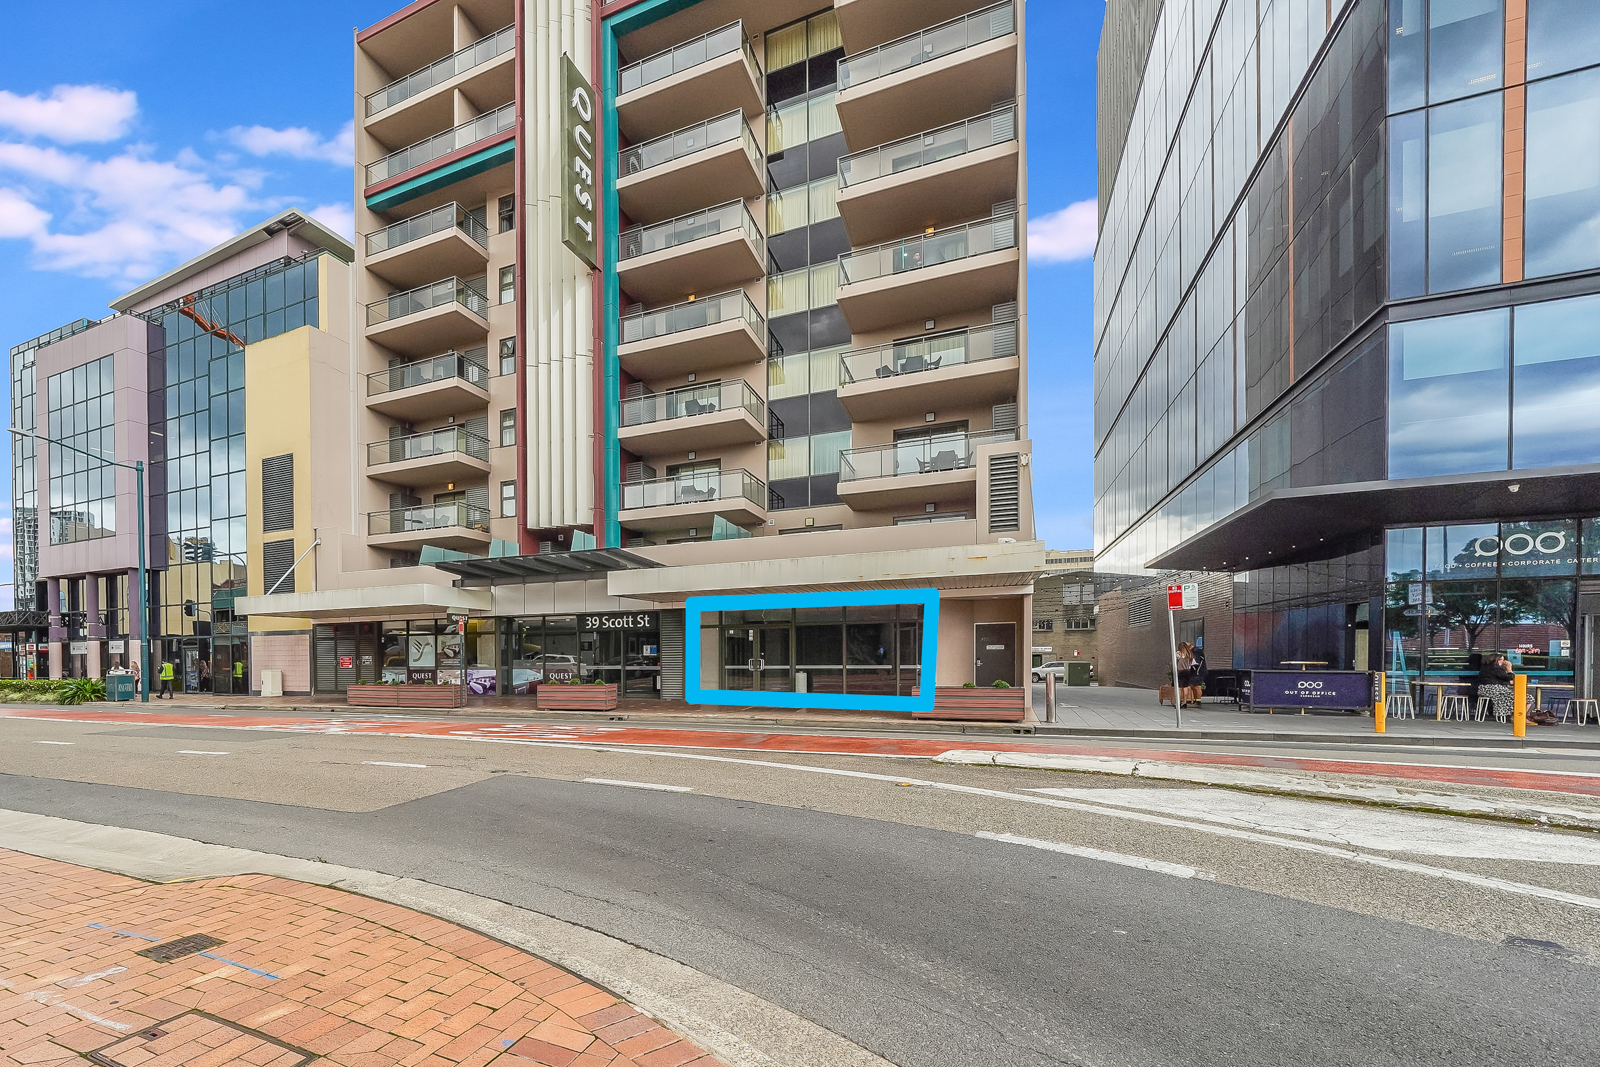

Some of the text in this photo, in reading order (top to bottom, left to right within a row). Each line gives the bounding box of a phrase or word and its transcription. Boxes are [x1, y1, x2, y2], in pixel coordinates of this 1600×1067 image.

[571, 86, 592, 243] QUEST
[1508, 558, 1561, 567] CORPORATE
[585, 614, 650, 629] 39 Scott St
[412, 672, 432, 680] QUEST
[549, 672, 573, 681] QUEST
